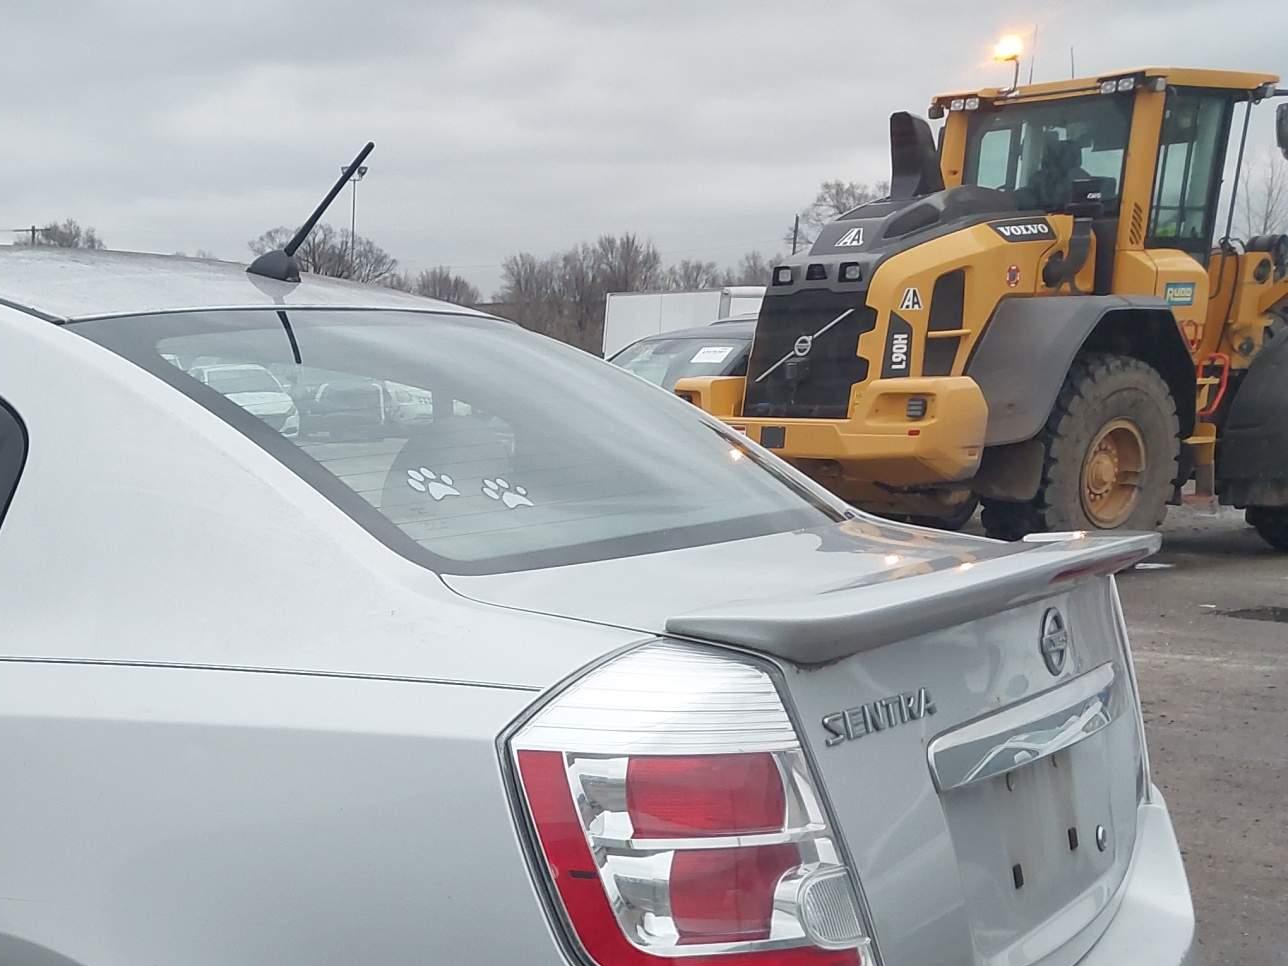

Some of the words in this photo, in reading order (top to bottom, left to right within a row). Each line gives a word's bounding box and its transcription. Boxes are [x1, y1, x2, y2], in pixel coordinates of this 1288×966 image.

[997, 223, 1049, 236] VOLVO
[891, 334, 908, 370] L90H
[822, 687, 937, 747] SENTRA
